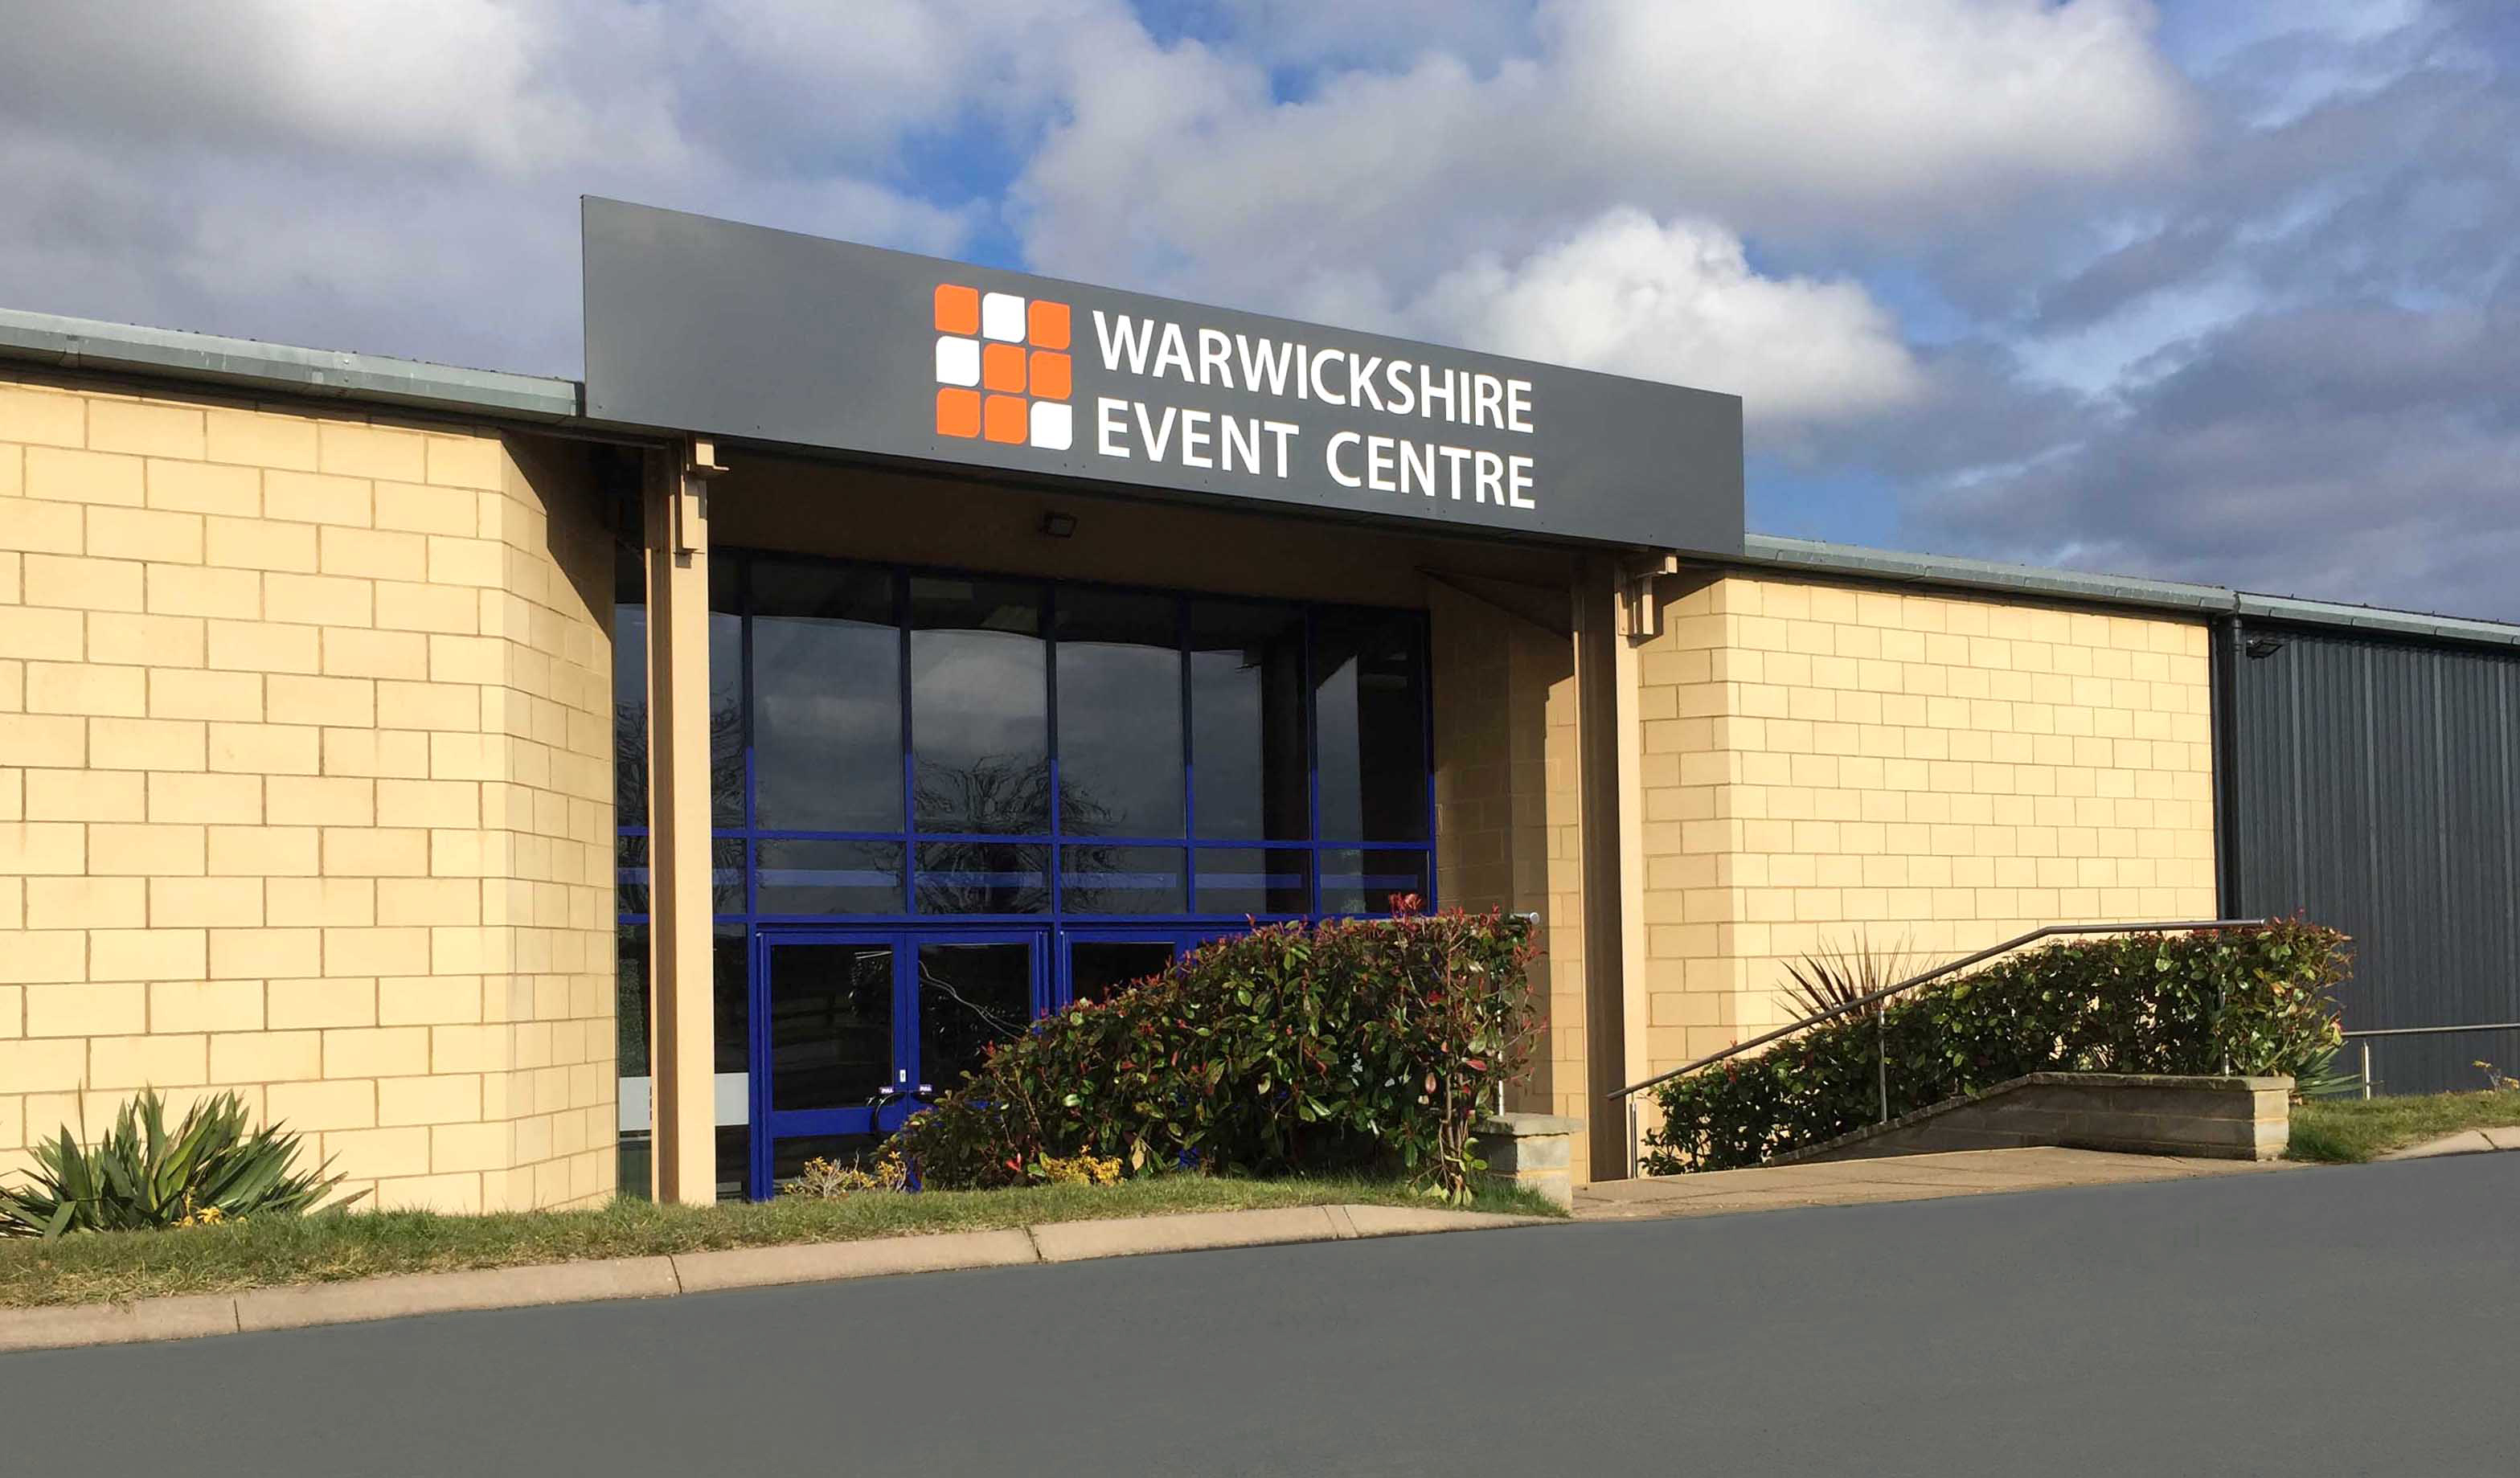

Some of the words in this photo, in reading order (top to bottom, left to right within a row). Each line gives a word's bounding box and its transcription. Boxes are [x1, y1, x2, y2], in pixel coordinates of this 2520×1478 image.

[1092, 309, 1534, 434] WARWICKSHIRE
[1097, 396, 1300, 479] EVENT
[1326, 431, 1535, 510] CENTRE
